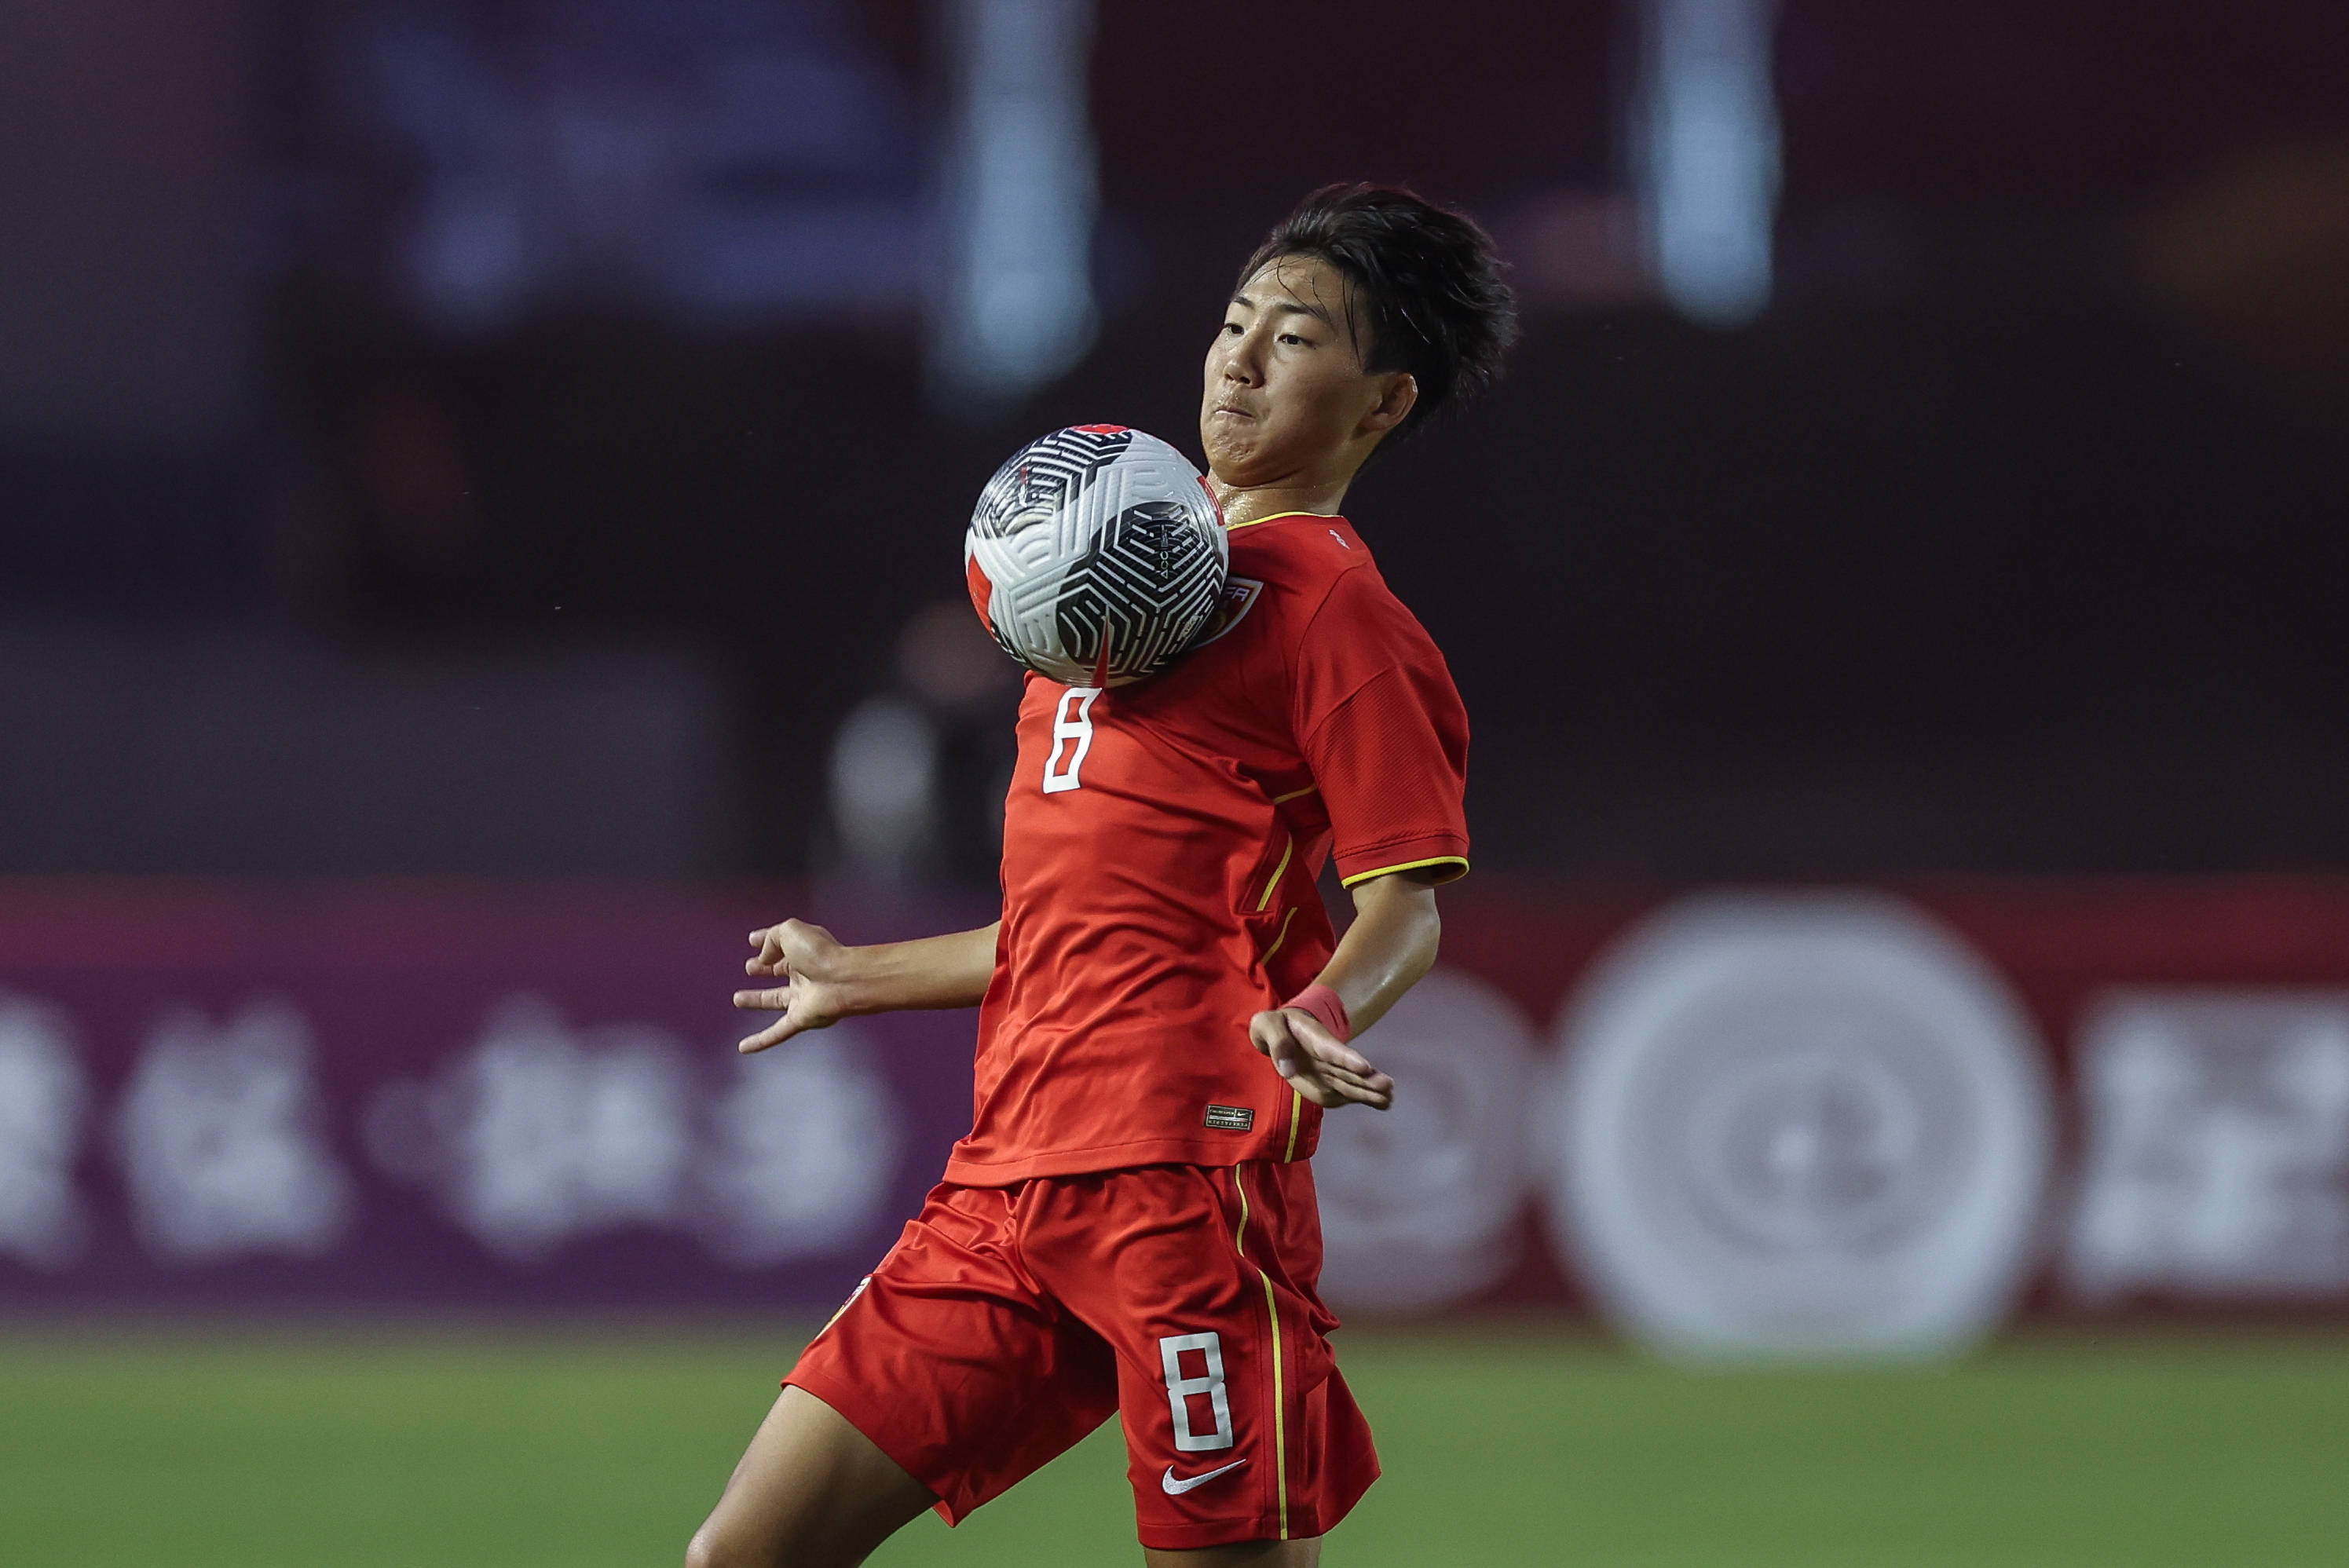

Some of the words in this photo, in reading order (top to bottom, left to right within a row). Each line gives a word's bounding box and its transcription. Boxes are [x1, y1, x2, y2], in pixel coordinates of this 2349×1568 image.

[1224, 586, 1250, 602] FA
[1042, 687, 1103, 795] 8
[1159, 1332, 1234, 1452] 8
